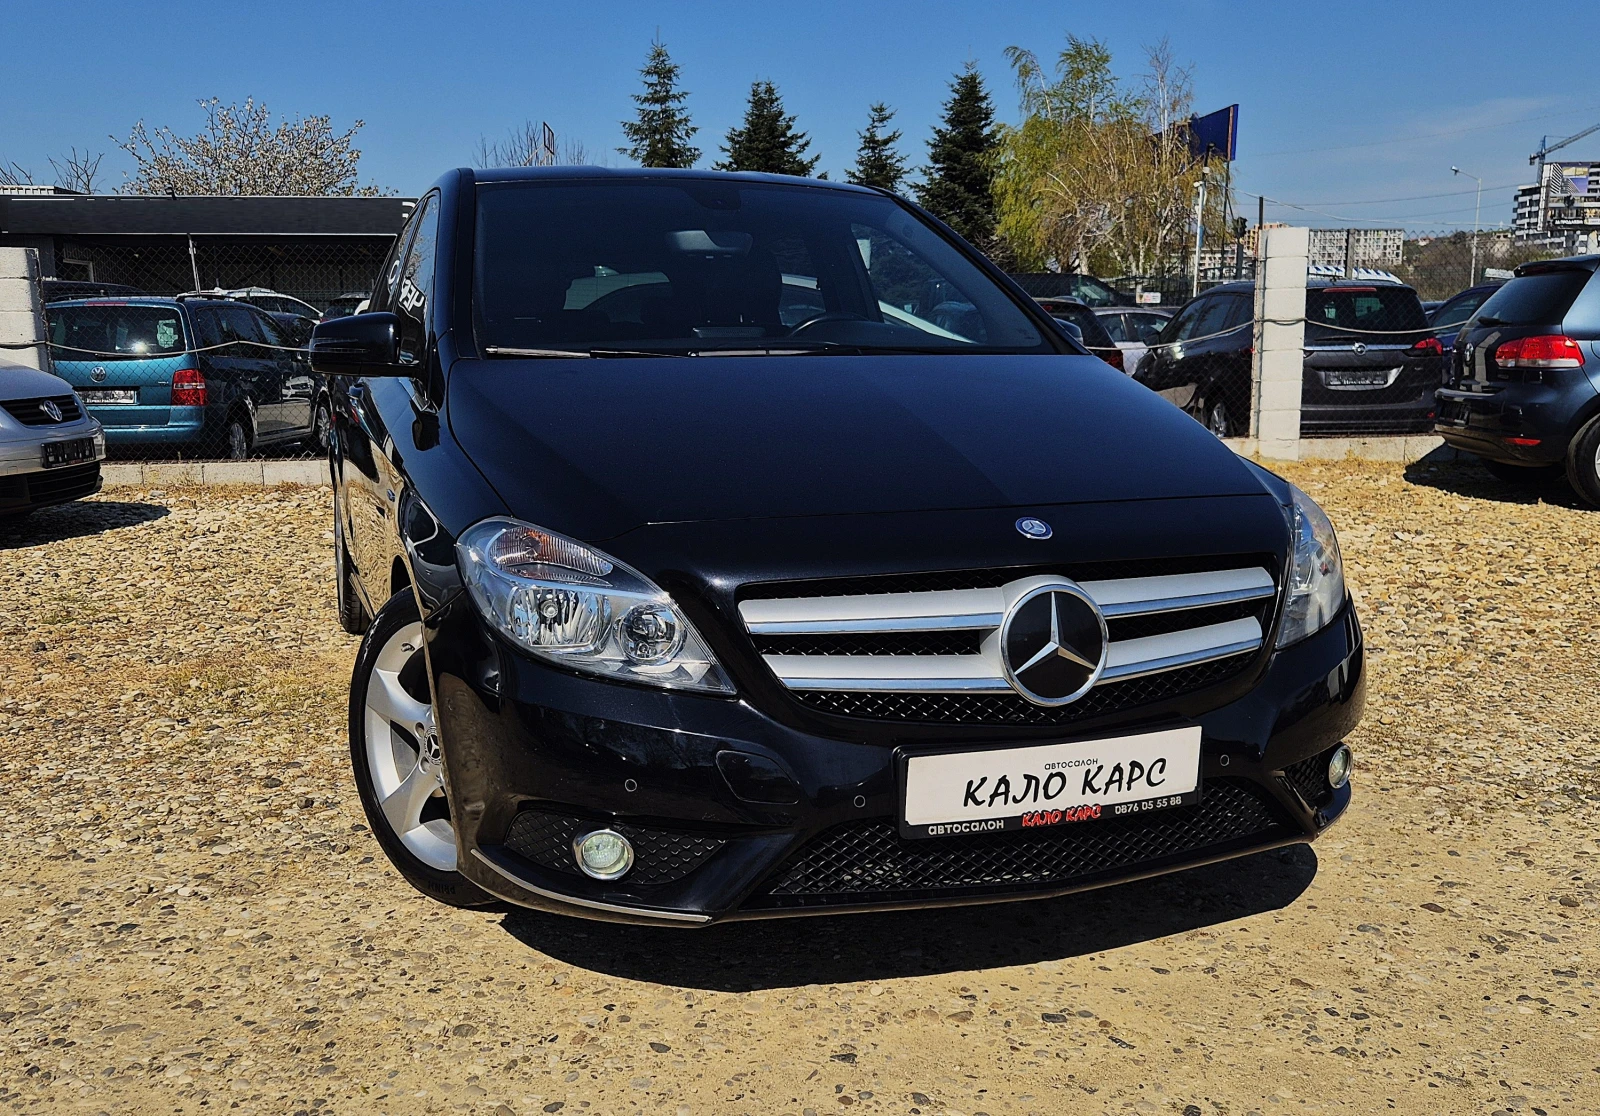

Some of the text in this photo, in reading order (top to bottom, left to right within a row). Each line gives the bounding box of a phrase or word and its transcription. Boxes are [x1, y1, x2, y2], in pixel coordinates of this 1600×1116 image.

[963, 758, 1167, 807] КАЛО КАРС
[1044, 758, 1098, 771] автосалон
[928, 796, 1182, 835] автосалон КАЛО КАРС 0876 05 55 88
